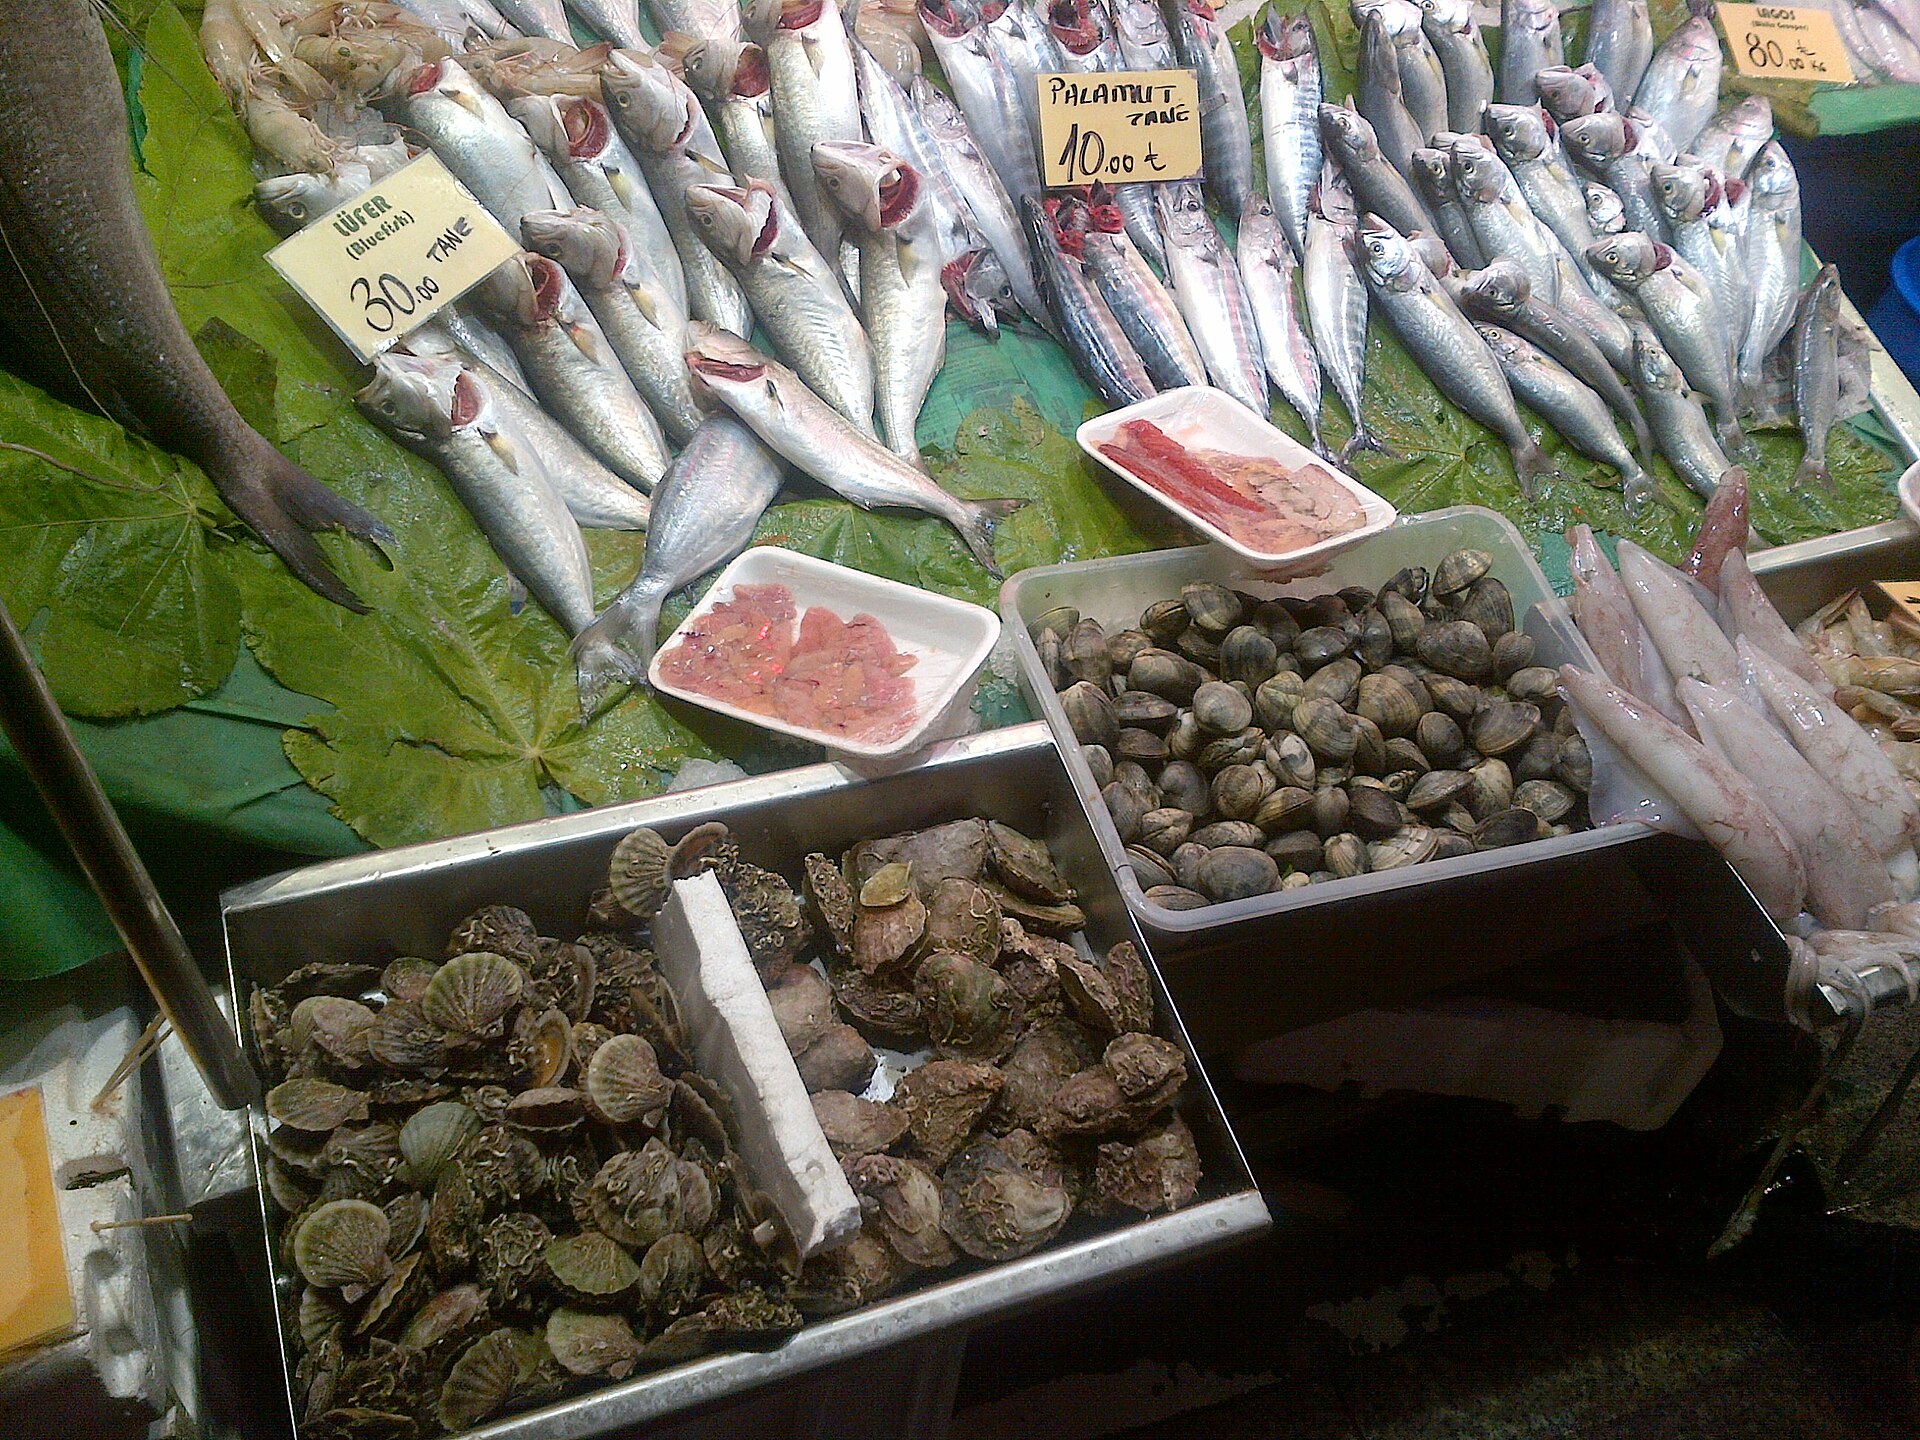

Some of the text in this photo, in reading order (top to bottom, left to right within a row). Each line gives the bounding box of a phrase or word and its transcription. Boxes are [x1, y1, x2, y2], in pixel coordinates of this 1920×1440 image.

[1756, 7, 1796, 20] LAGOS
[1049, 77, 1176, 106] PALAMUT
[1126, 104, 1190, 126] TANE
[1059, 123, 1134, 182] 10.00
[333, 195, 393, 237] LÜFER
[345, 210, 415, 261] (Bluefish)
[426, 216, 475, 263] TANE
[350, 273, 440, 332] 30.00
